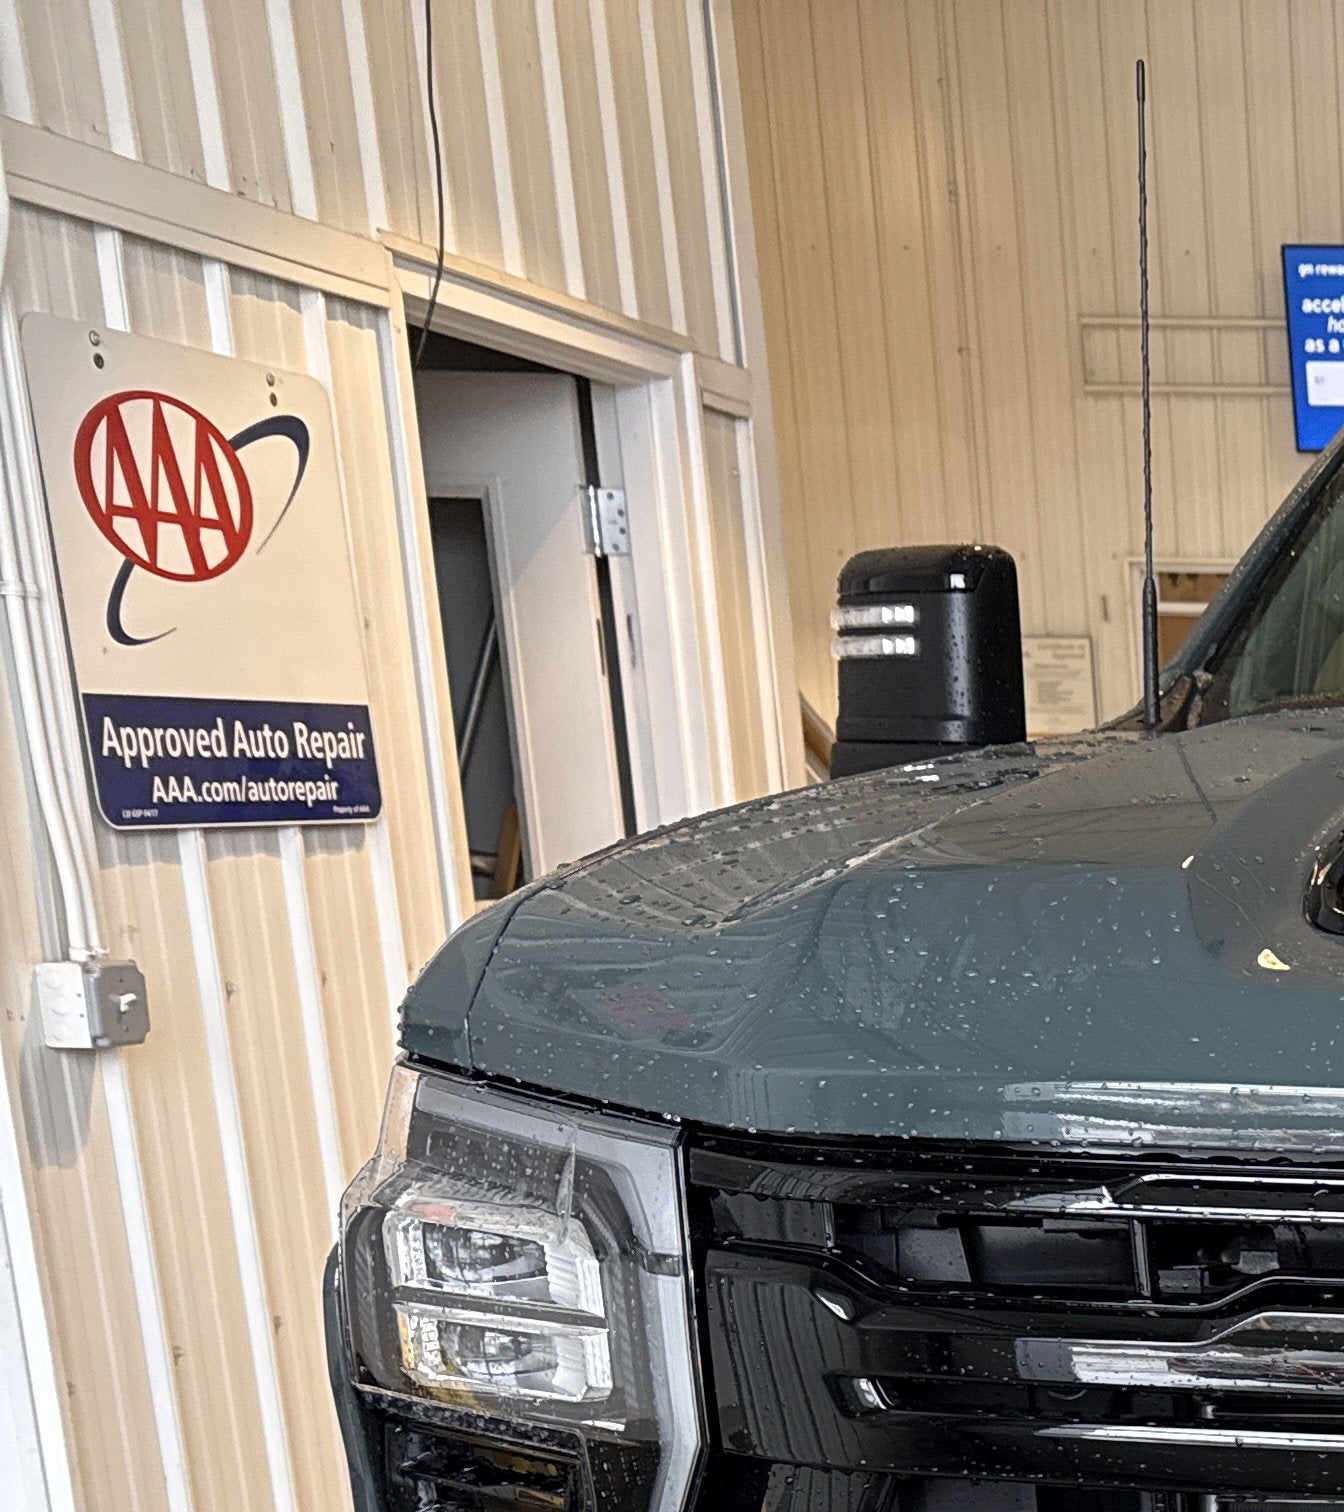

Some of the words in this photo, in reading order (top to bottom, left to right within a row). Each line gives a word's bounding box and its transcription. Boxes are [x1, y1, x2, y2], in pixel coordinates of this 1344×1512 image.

[1304, 338, 1325, 353] as
[1328, 338, 1340, 353] a
[96, 396, 246, 581] AAA
[102, 716, 228, 769] Approved
[233, 719, 289, 759] Auto
[292, 721, 366, 769] Repair
[152, 774, 339, 808] AAA.com/autorepair
